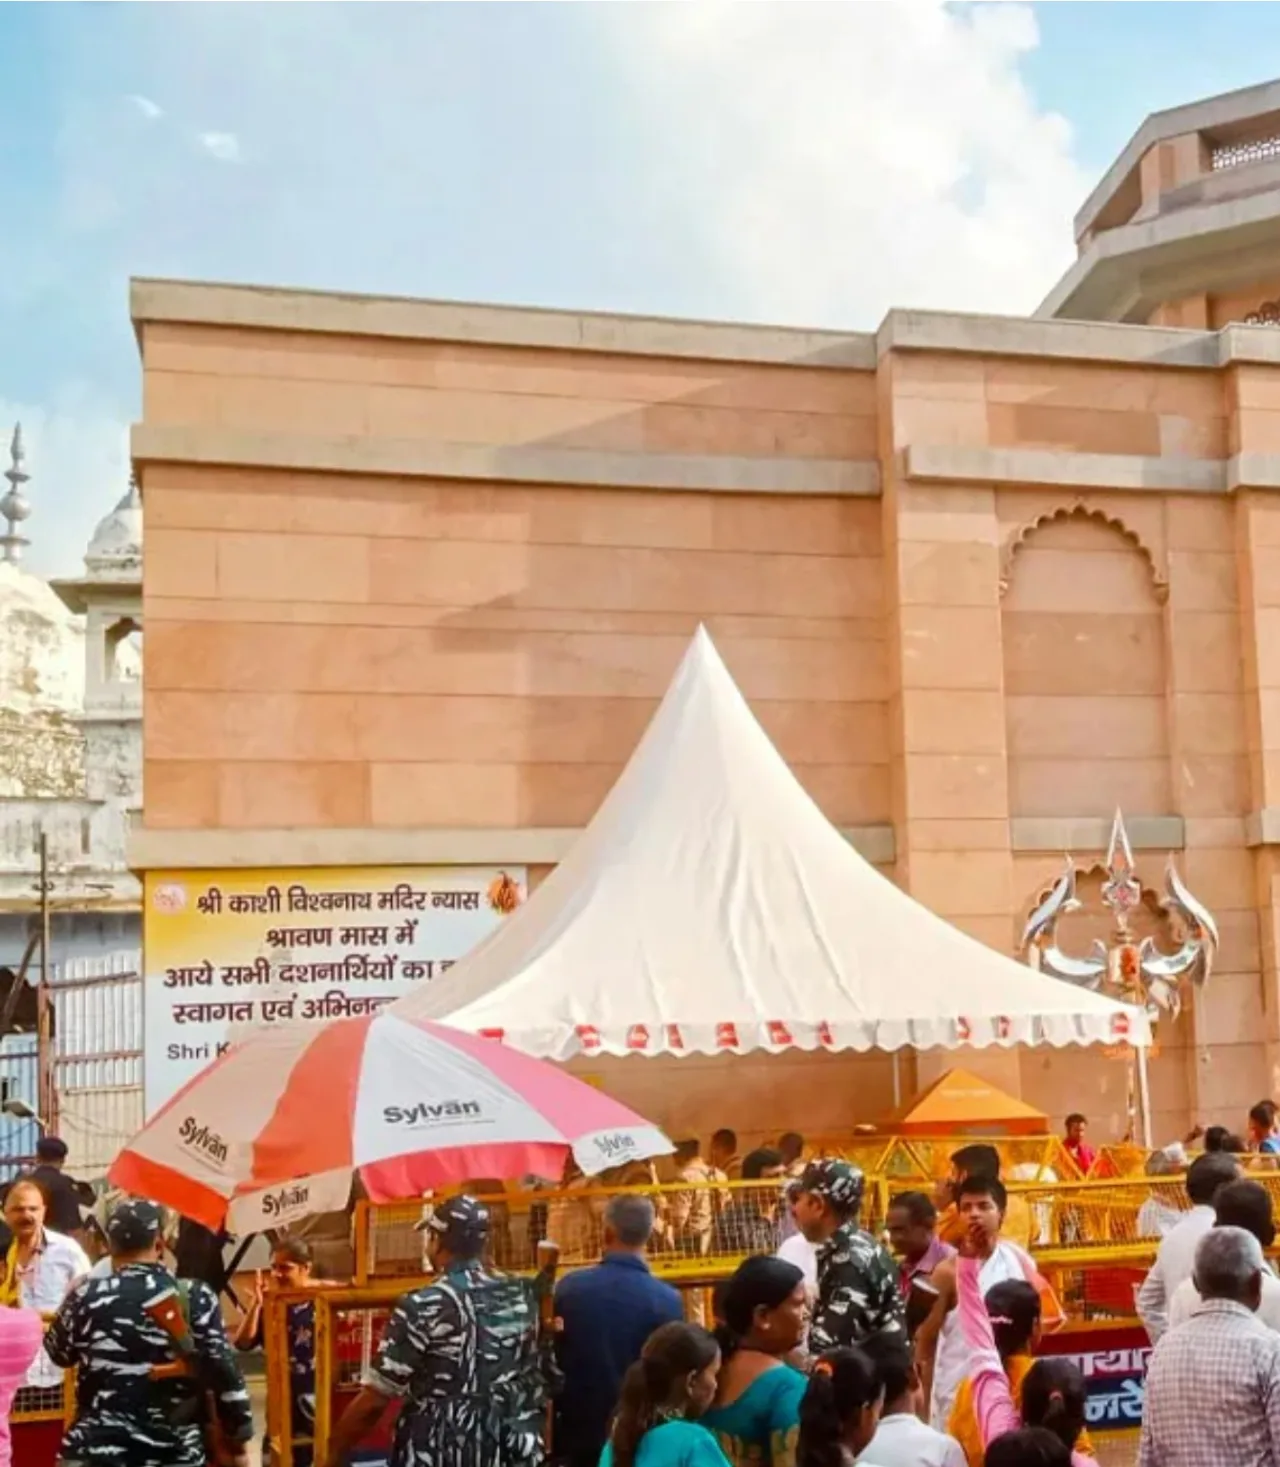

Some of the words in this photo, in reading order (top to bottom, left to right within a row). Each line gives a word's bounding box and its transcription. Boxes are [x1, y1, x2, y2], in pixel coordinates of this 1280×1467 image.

[197, 887, 222, 914] श्री
[229, 886, 280, 913] काशी
[288, 885, 372, 913] विश्वनाथ
[431, 891, 479, 910] न्यास
[266, 927, 333, 948] श्रावण
[340, 926, 388, 946] मास
[395, 918, 419, 945] में
[163, 959, 213, 988] आये
[220, 956, 271, 986] सभी
[401, 960, 432, 979] का
[172, 1001, 253, 1024] स्वागत
[261, 993, 298, 1021] एवं
[168, 1043, 209, 1060] Shri
